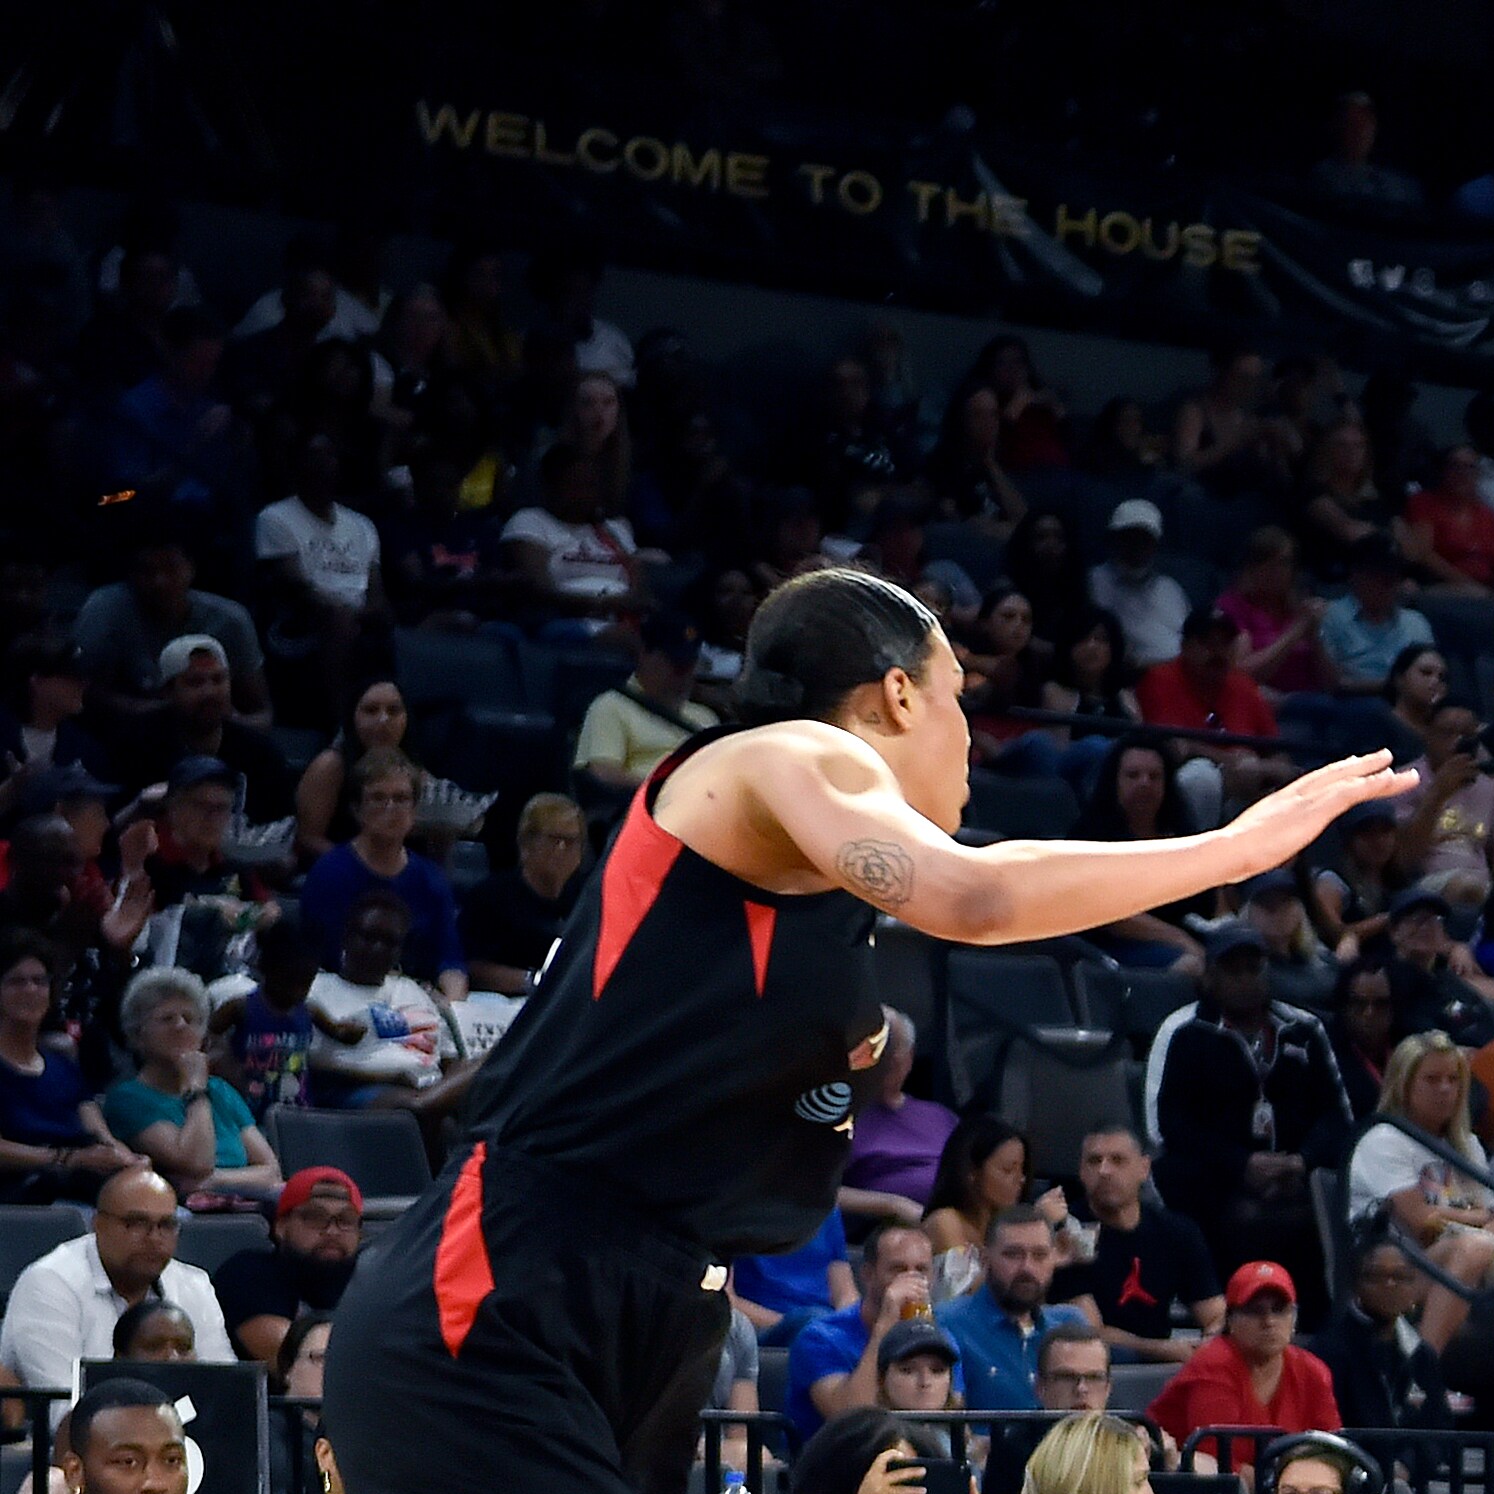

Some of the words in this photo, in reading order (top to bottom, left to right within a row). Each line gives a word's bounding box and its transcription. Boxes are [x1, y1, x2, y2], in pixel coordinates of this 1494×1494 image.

[415, 100, 771, 199] WELCOME
[799, 162, 885, 216] TO
[908, 179, 1030, 240] THE
[1054, 203, 1263, 274] HOUSE
